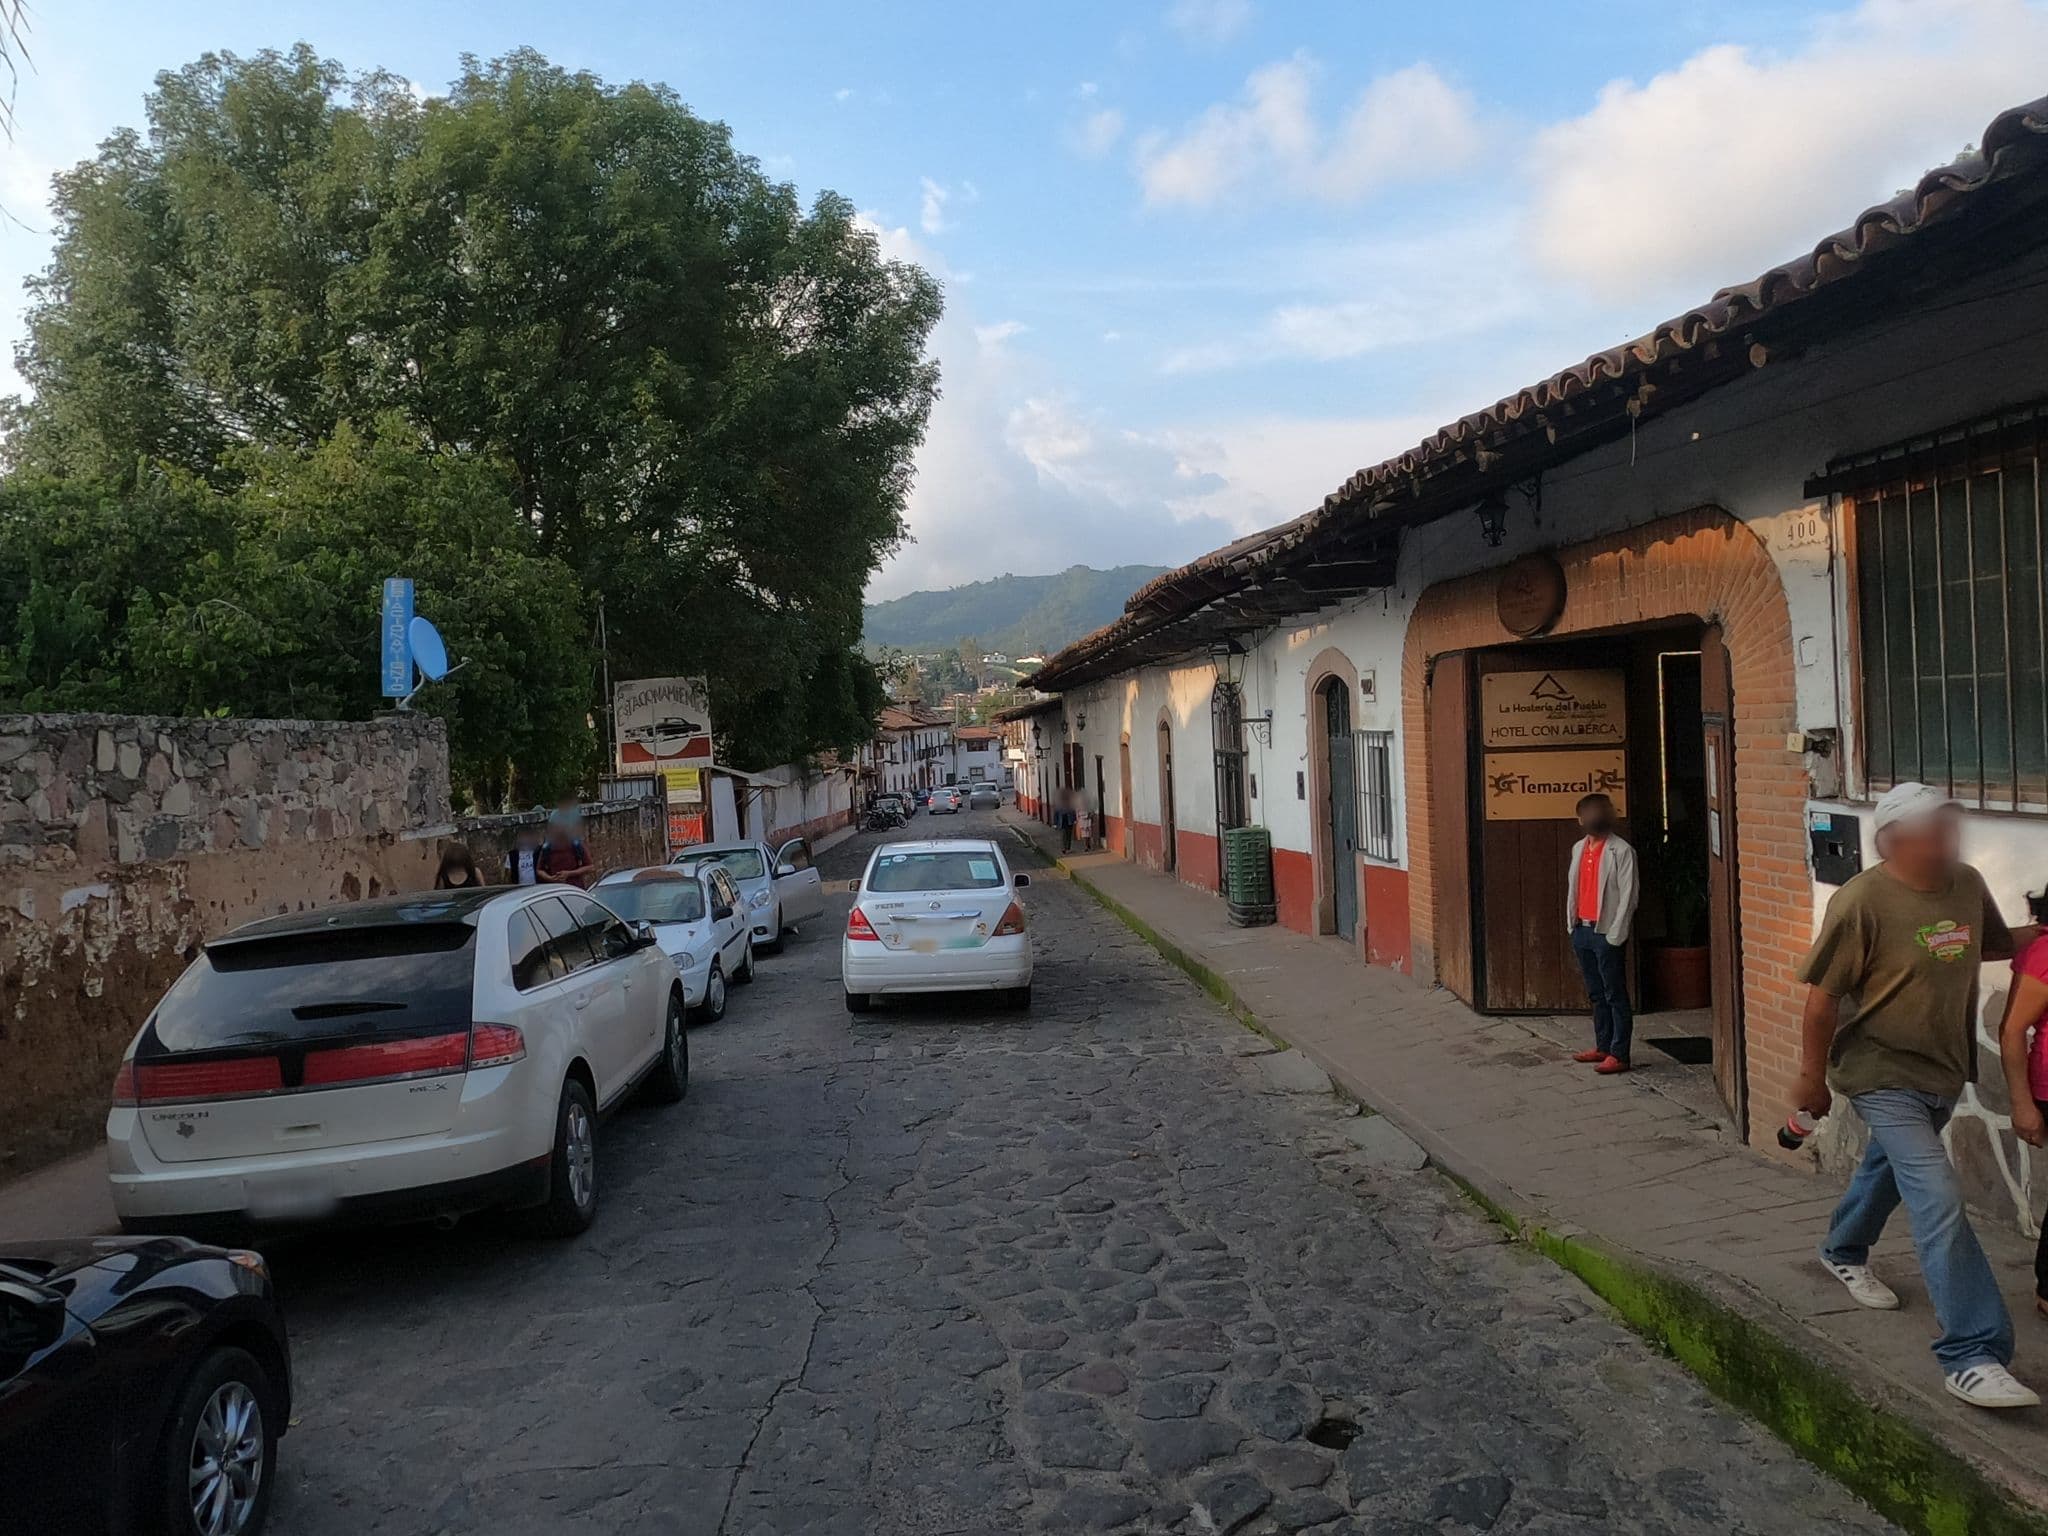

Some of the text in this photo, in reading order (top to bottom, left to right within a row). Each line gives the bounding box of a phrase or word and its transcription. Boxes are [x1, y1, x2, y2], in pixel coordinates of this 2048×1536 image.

[1787, 519, 1816, 540] 400
[1499, 703, 1511, 713] La
[1555, 701, 1571, 711] del
[1573, 700, 1607, 711] Pueblo
[1491, 723, 1618, 738] HOTEL CON ALBERCA
[1517, 773, 1593, 794] Temazcal
